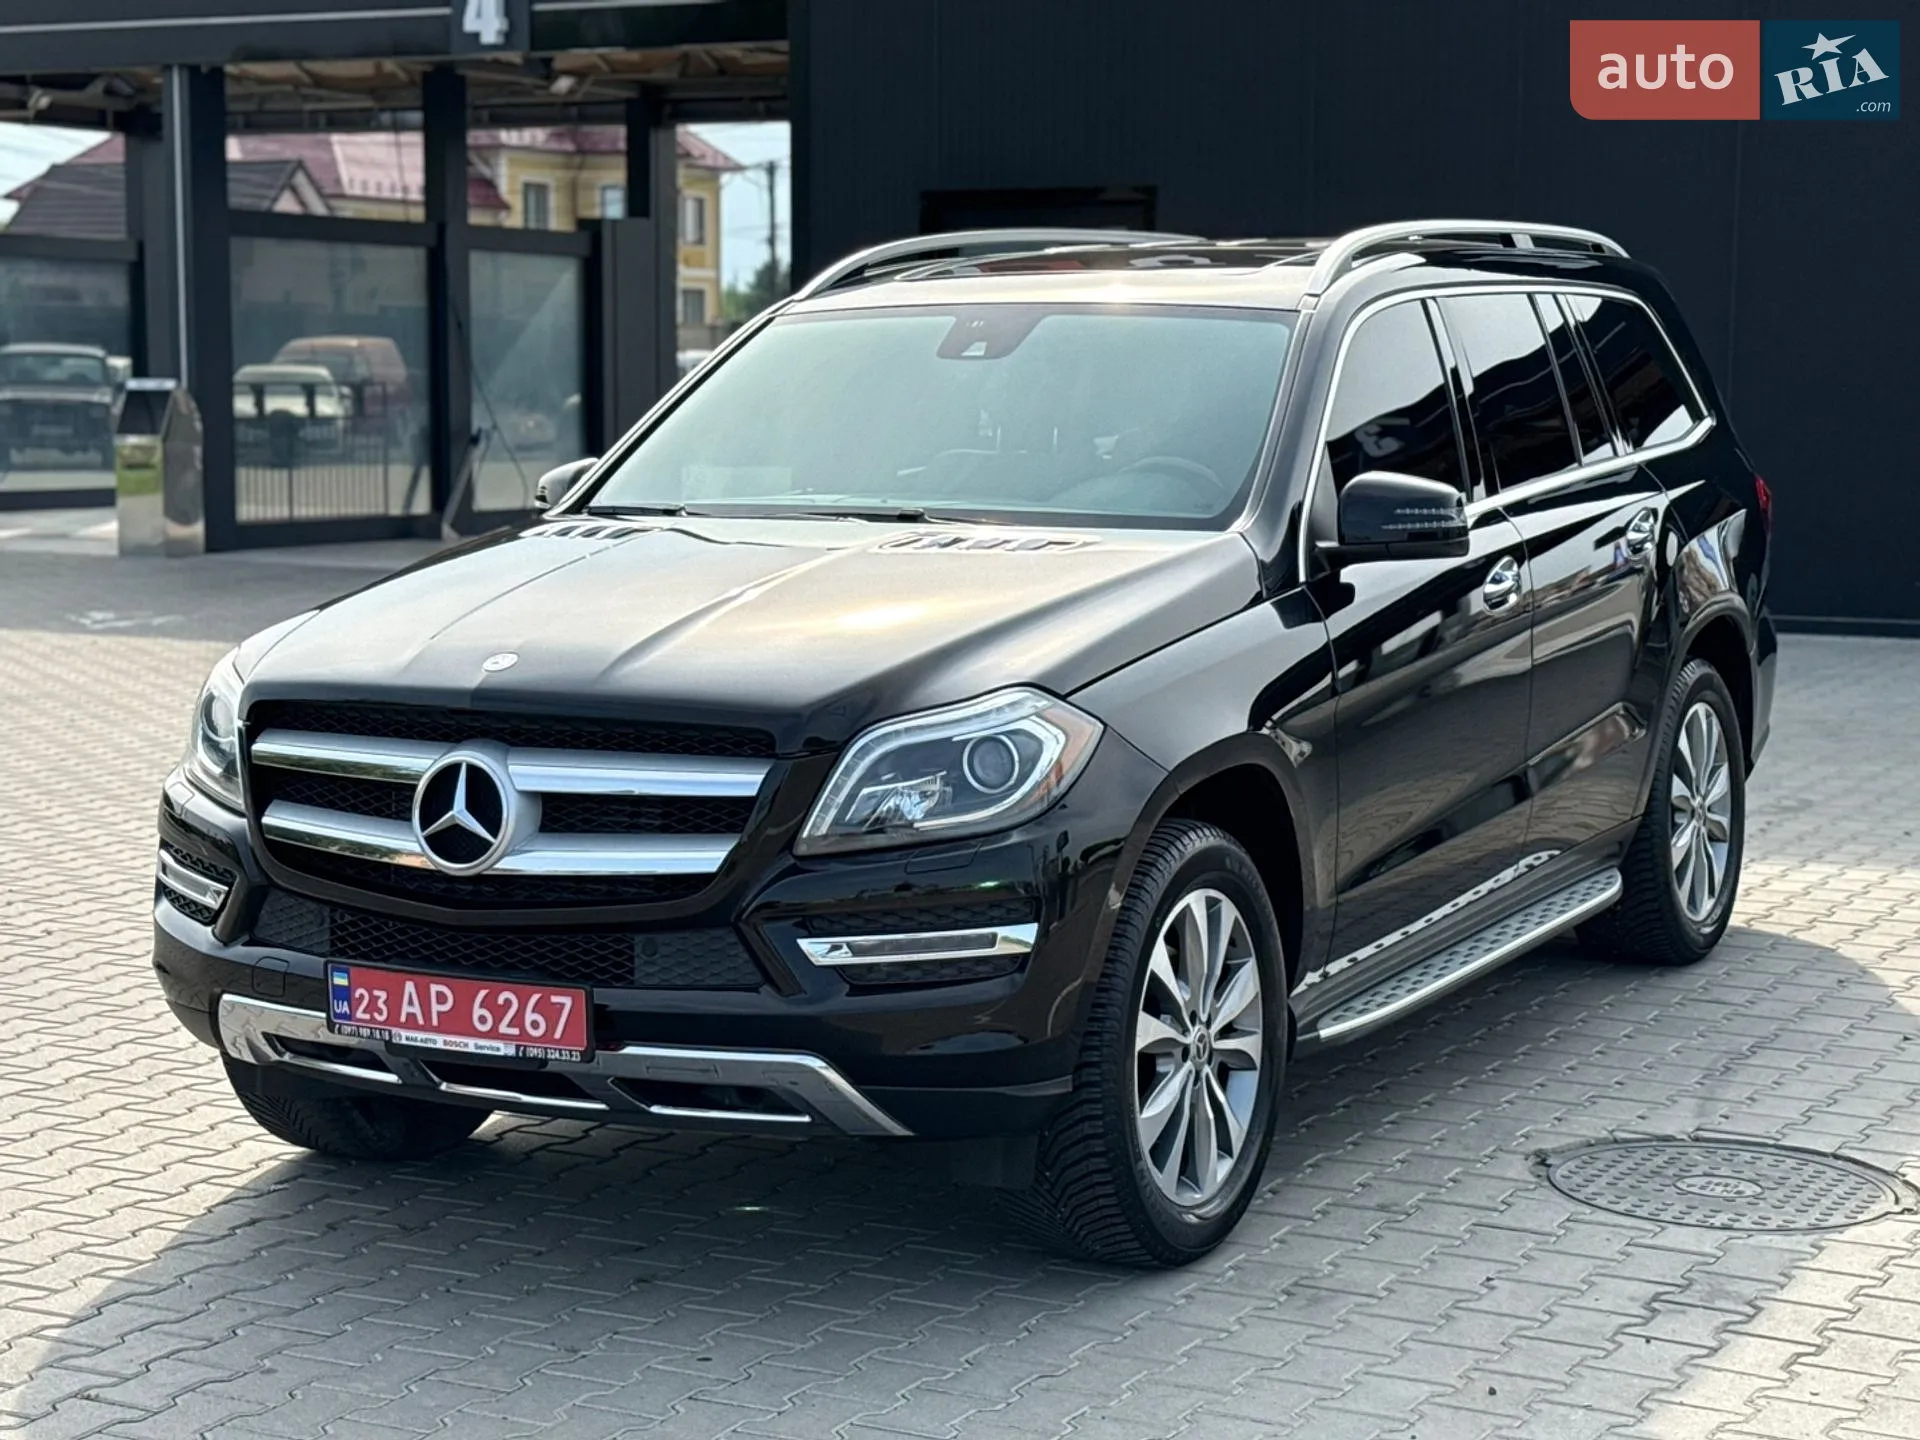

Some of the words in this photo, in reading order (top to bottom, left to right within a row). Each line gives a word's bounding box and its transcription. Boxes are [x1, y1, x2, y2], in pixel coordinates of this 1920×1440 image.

[462, 0, 509, 45] 4
[334, 1000, 350, 1015] UA
[354, 987, 389, 1022] 23
[400, 981, 454, 1027] AP
[472, 988, 573, 1040] 6267
[443, 1039, 470, 1049] BOSCH
[474, 1041, 502, 1053] Service
